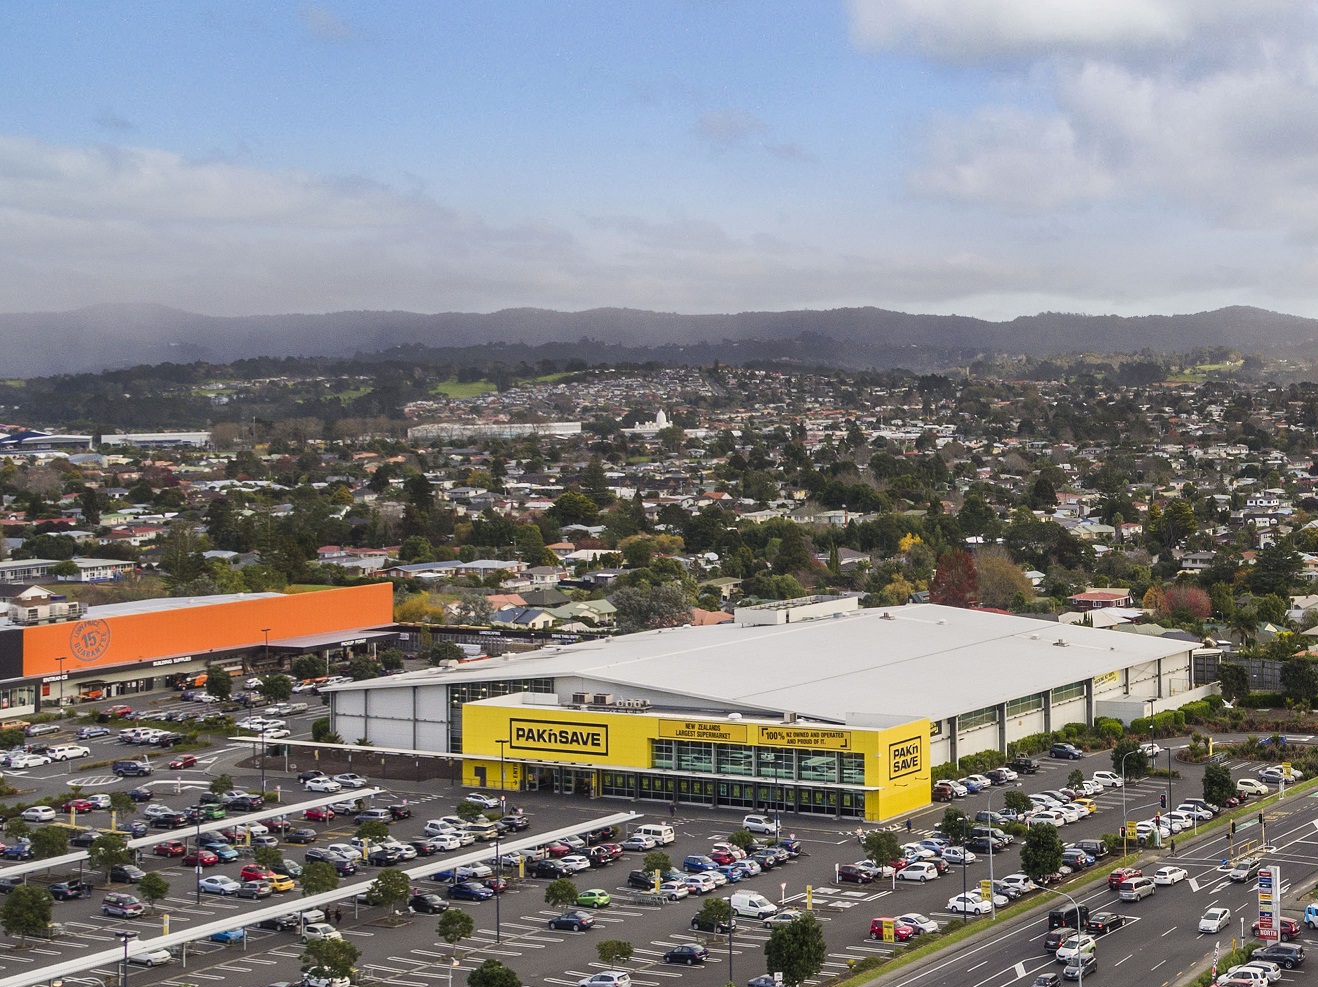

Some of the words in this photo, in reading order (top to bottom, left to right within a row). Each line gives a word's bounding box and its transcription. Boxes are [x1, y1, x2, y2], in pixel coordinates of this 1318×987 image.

[153, 659, 172, 667] BUILDING
[173, 656, 191, 664] SUPPLIES
[697, 731, 731, 739] SUPERMARKET
[766, 731, 785, 740] 100%
[893, 755, 919, 773] SAVE
